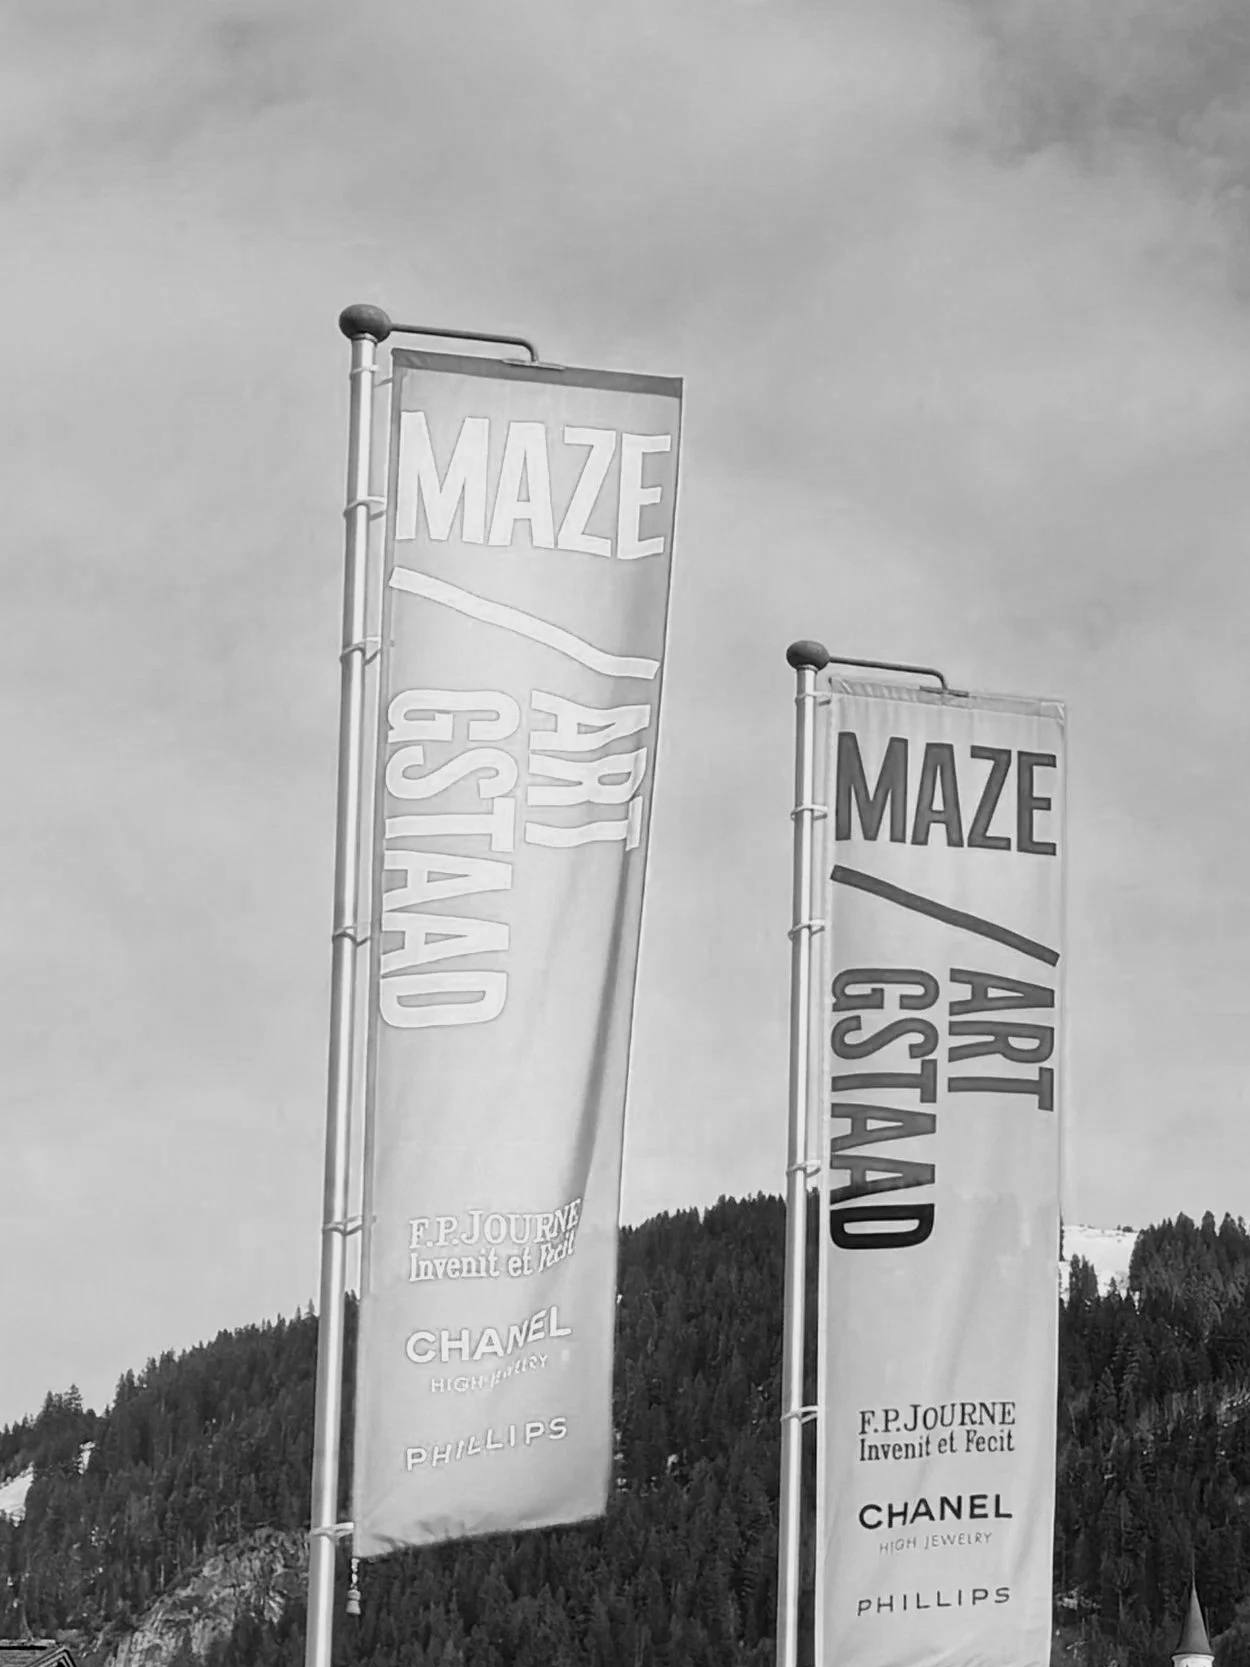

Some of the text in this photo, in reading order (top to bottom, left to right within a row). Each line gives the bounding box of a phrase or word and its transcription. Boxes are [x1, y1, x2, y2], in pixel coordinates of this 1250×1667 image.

[395, 410, 671, 560] MAZE
[524, 690, 651, 852] ART
[835, 731, 1057, 856] MAZE
[378, 689, 521, 1029] GSTAAD
[947, 967, 1055, 1112] ART
[830, 968, 941, 1250] GSTAAD
[409, 1247, 500, 1282] Invenit
[508, 1247, 533, 1277] et
[406, 1305, 572, 1364] CHANEL
[431, 1376, 484, 1393] HIGH
[406, 1417, 567, 1471] PHILLIPS
[859, 1429, 1016, 1461] Invenit et Fecit
[858, 1494, 1013, 1530] CHANEL
[879, 1532, 992, 1554] HIGH JEWELRY
[857, 1587, 1010, 1616] PHILLIPS
